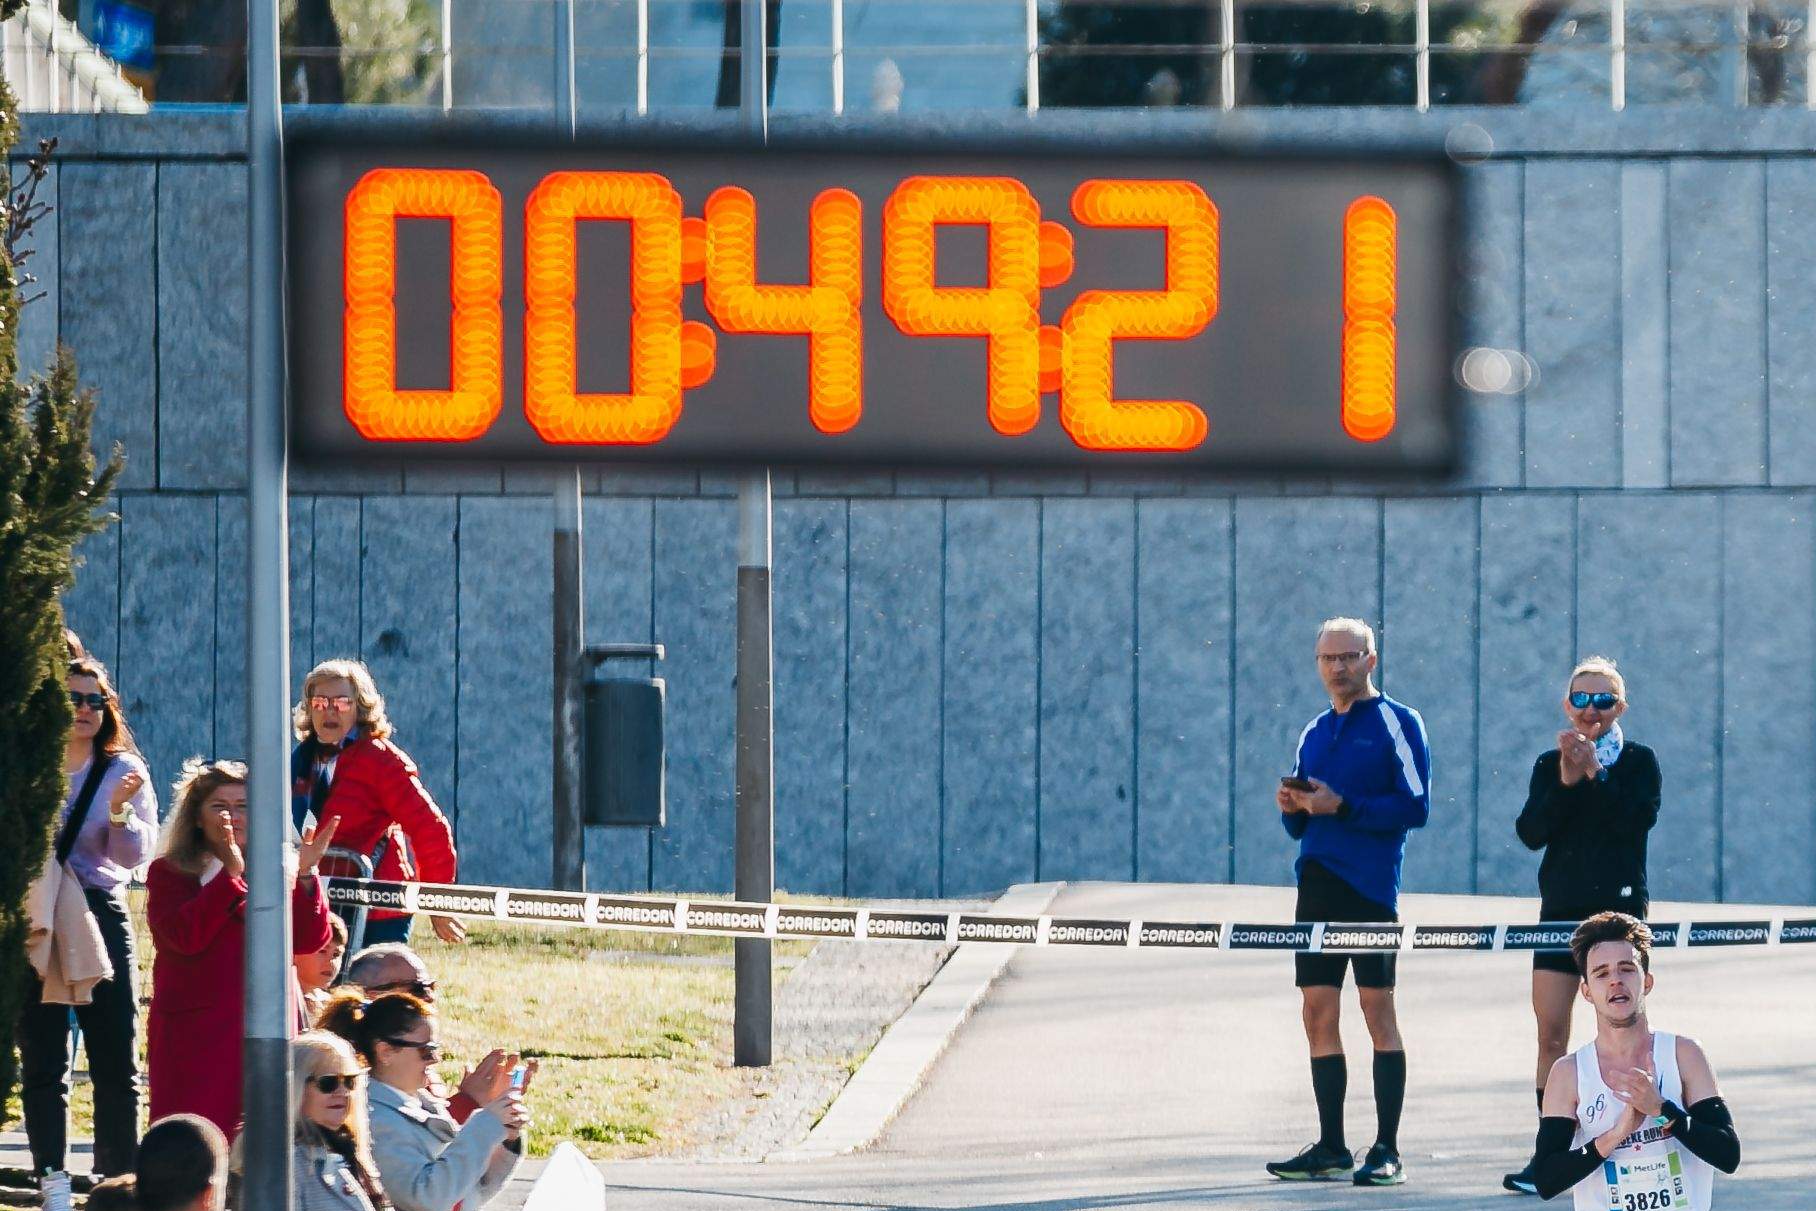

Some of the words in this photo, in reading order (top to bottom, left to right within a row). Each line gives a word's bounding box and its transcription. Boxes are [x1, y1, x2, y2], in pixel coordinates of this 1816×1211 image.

[1506, 931, 1577, 943] CORREDO
[1634, 1162, 1666, 1172] MetLife
[1624, 1189, 1671, 1211] 3826
